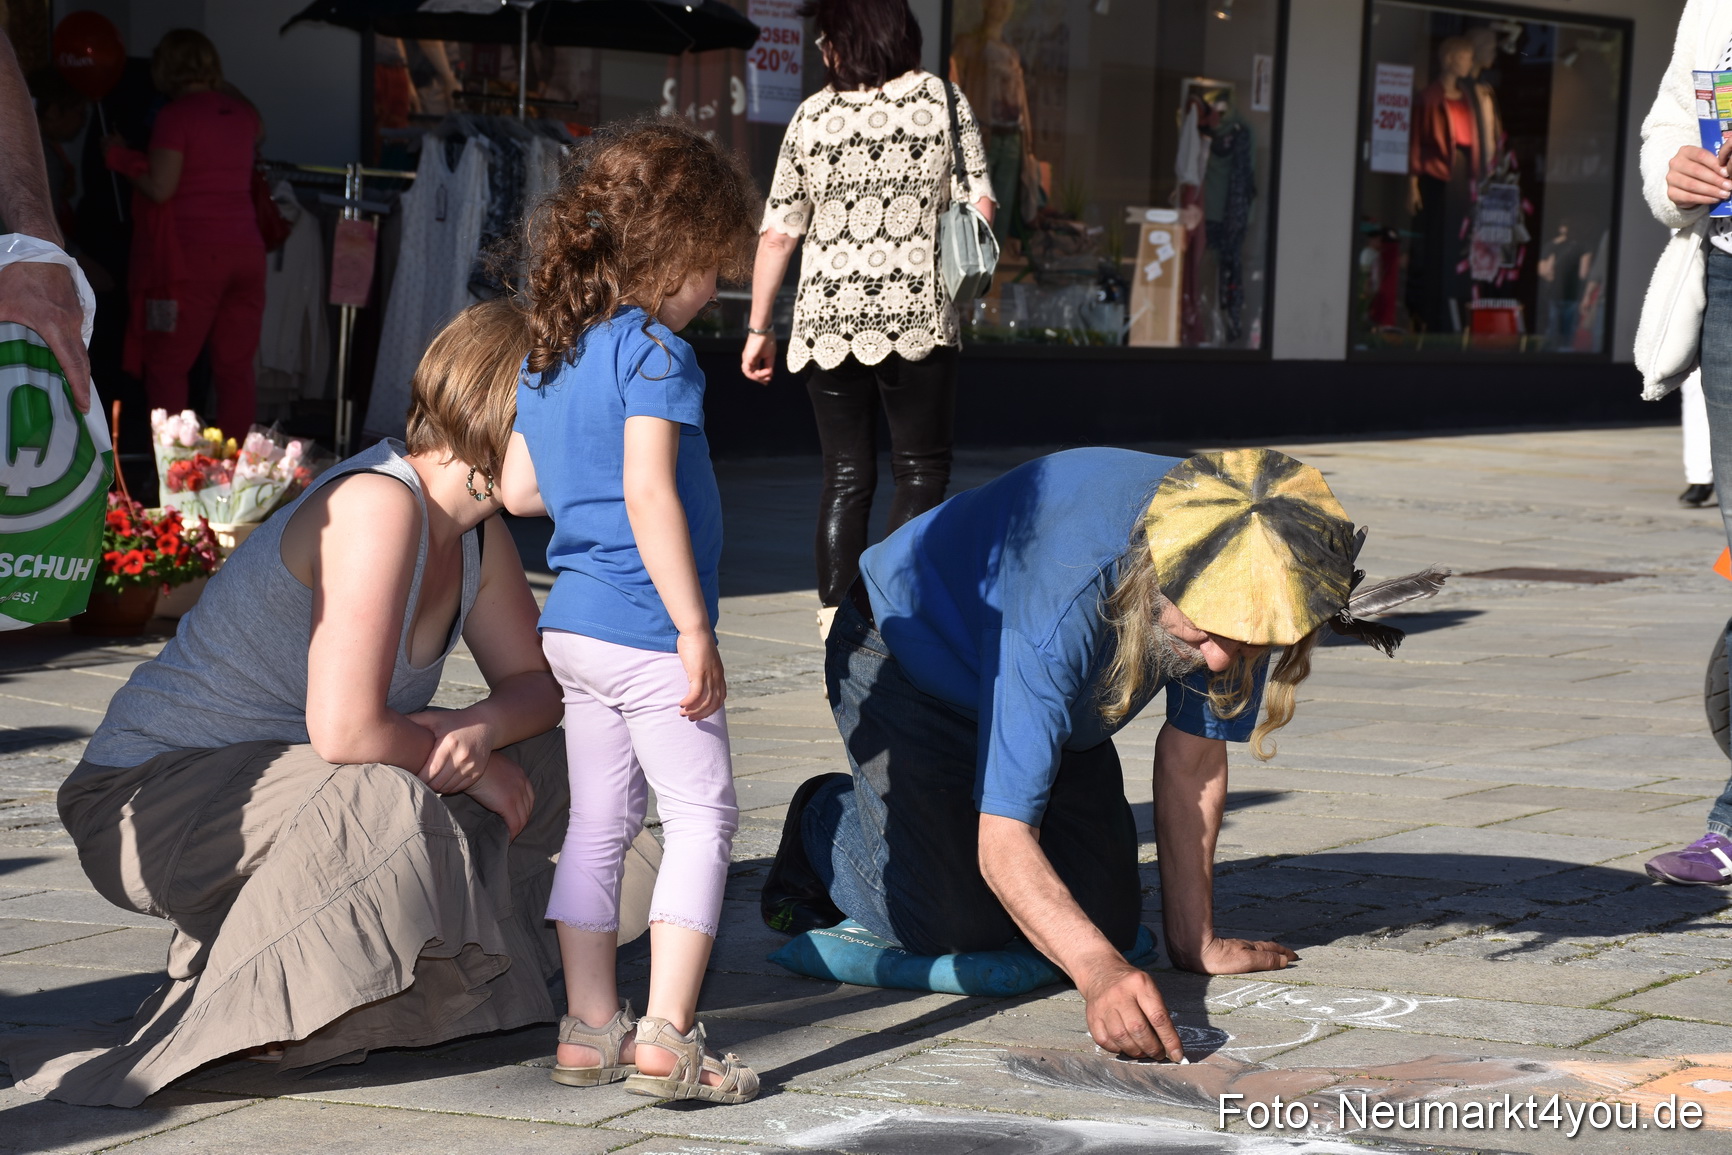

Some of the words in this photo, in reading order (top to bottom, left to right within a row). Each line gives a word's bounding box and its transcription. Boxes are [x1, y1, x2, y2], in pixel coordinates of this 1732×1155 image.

[756, 26, 800, 46] OSEN
[749, 47, 799, 75] -20%
[1377, 93, 1410, 108] HOSEN
[1374, 110, 1408, 131] -20%
[0, 553, 94, 581] SCHUH
